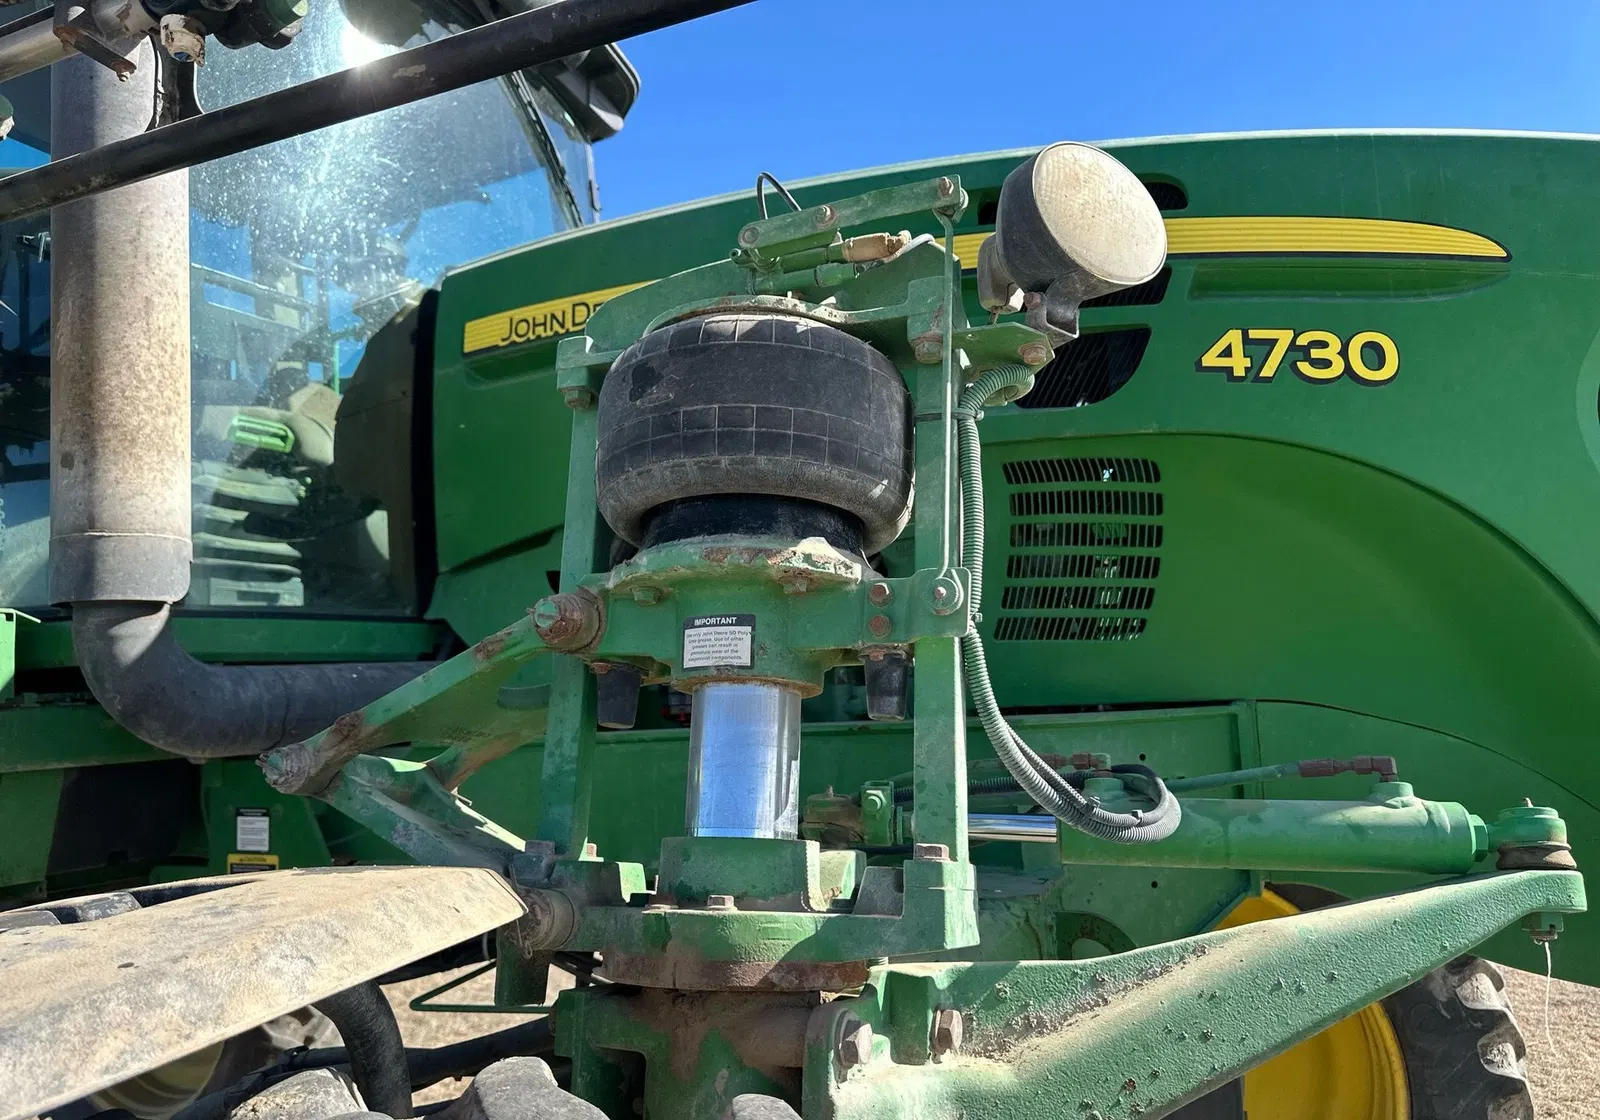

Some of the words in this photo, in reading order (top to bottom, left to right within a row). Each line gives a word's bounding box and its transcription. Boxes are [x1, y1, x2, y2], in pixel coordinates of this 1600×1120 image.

[501, 310, 565, 341] JOHN
[1195, 328, 1400, 386] 4730
[694, 617, 737, 626] IMPORTANT
